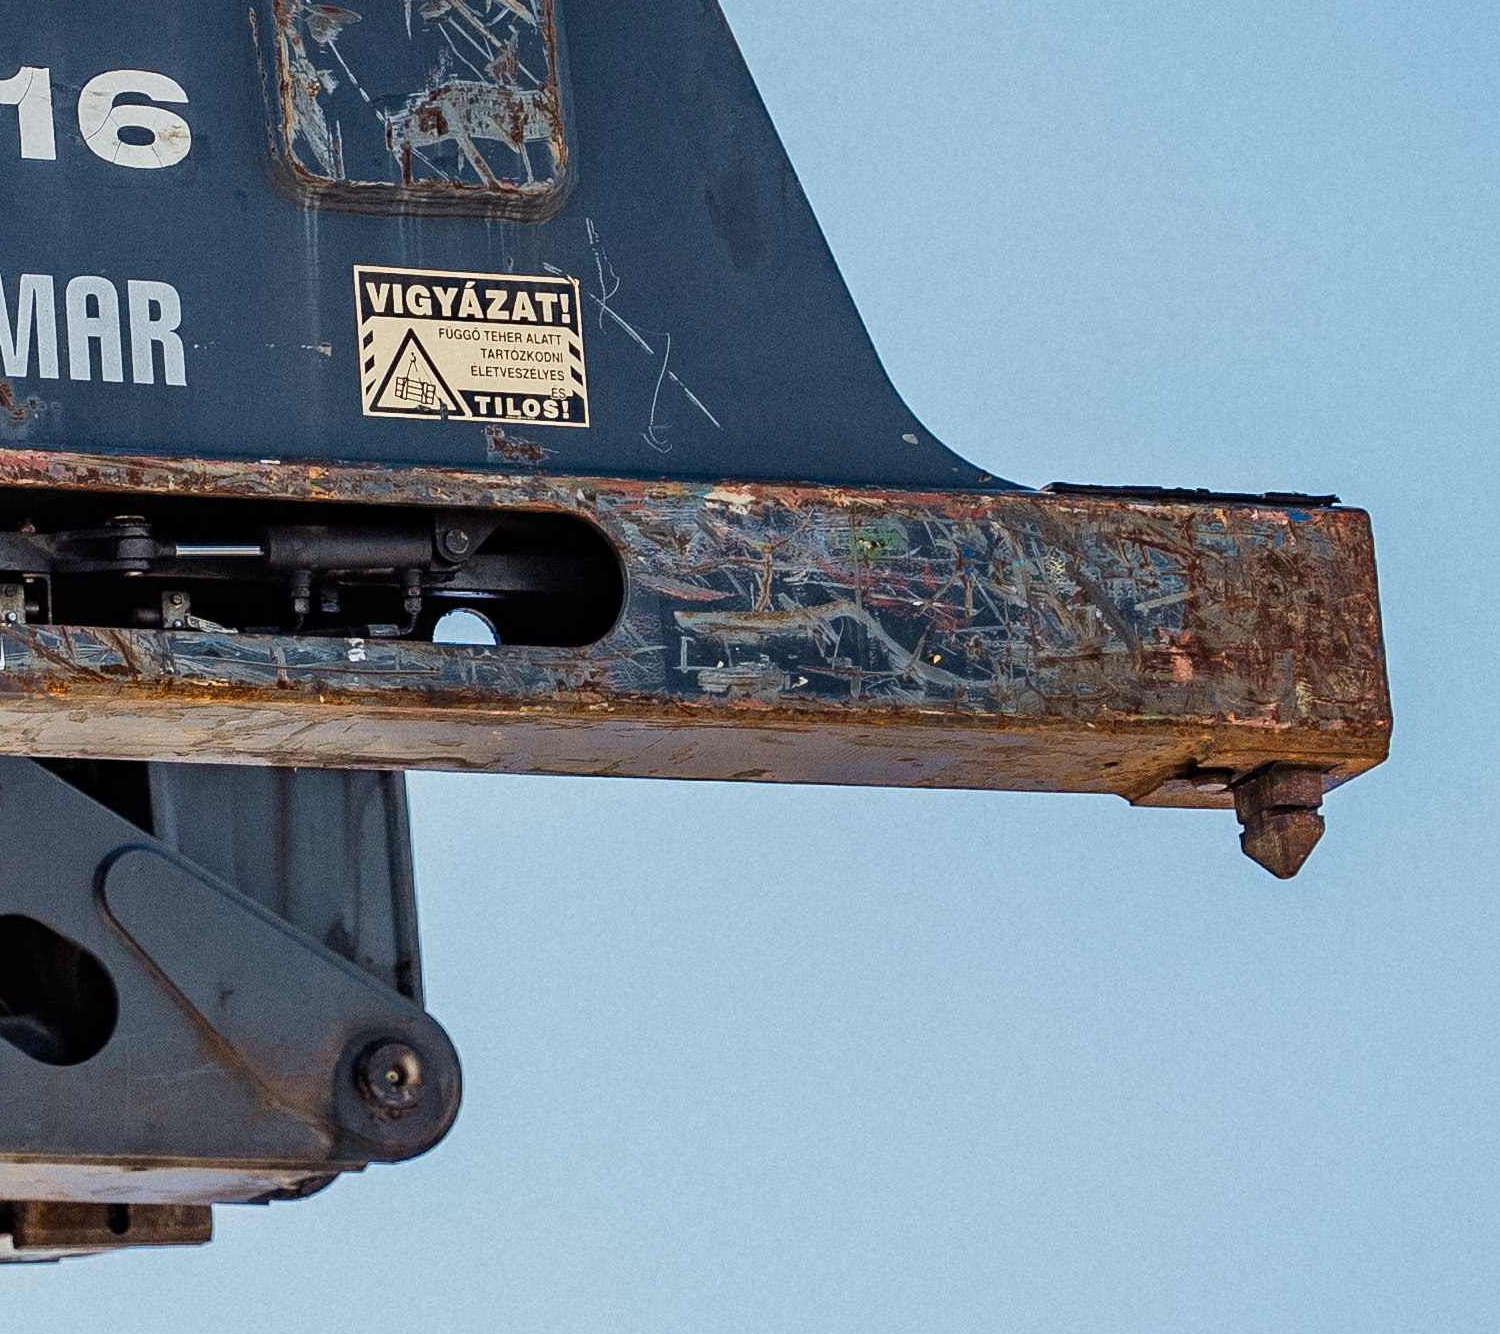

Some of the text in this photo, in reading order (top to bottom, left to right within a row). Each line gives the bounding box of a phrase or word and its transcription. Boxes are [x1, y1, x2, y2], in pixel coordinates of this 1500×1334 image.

[365, 280, 571, 324] VIGYÁZAT!
[483, 330, 522, 343] TEHER
[526, 333, 562, 346] ALATT
[480, 347, 564, 363] TARTÓZKODNI
[470, 362, 565, 382] ÉLETVESZÉLYES
[551, 384, 566, 399] ÉS
[474, 395, 570, 420] TILOS!
